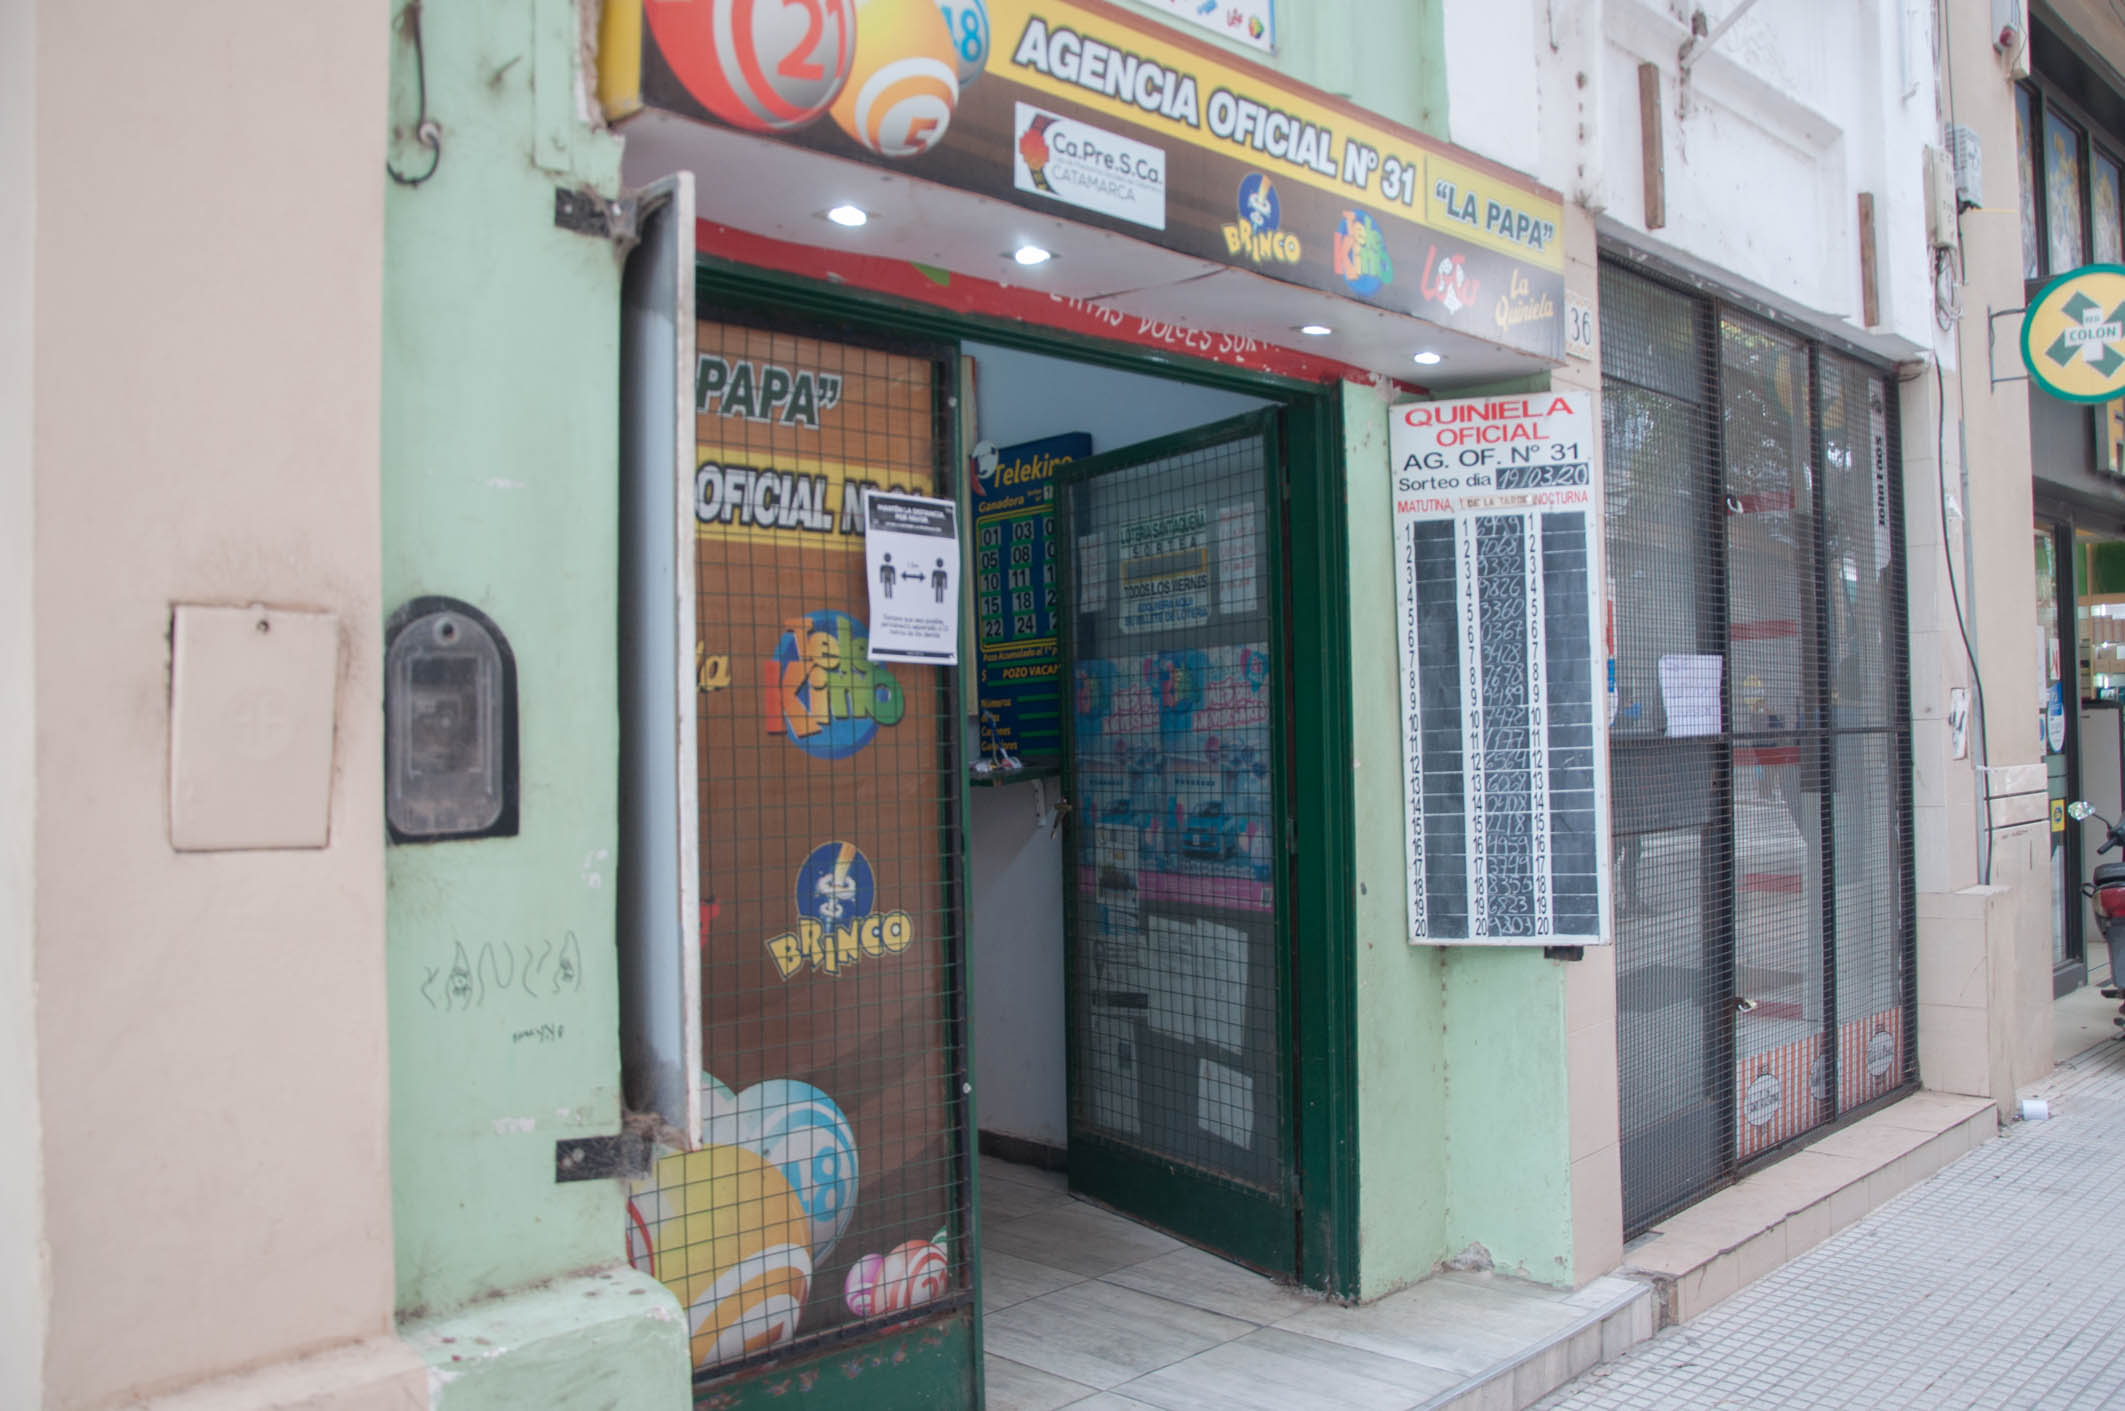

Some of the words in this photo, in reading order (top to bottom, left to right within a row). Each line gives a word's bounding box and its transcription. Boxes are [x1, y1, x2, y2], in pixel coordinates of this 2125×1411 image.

[1011, 13, 1200, 128] AGENCIA
[1207, 86, 1337, 179] OFICIAL
[1381, 154, 1416, 208] 31
[1051, 163, 1136, 201] CATAMARCA
[1220, 216, 1301, 264] BRINCO
[1510, 268, 1529, 299] La
[1495, 293, 1554, 332] Quiniela
[1570, 306, 1592, 346] 36
[2069, 325, 2117, 341] COLON
[1404, 396, 1574, 427] QUINIELA
[1436, 421, 1550, 447] OFICIAL
[1403, 452, 1449, 472] AG.
[1458, 447, 1502, 467] OF.
[1550, 443, 1579, 462] 31
[1399, 477, 1459, 492] Sorteo
[1466, 472, 1491, 487] dia
[694, 462, 834, 533] OFICIAL
[1397, 497, 1452, 513] MATUTINA
[1463, 518, 1468, 536] 1
[1528, 513, 1533, 530] 1
[983, 529, 999, 546] 01
[1015, 522, 1033, 539] 03
[1405, 524, 1410, 541] 1
[1464, 541, 1470, 558] 2
[1530, 535, 1536, 552] 2
[982, 551, 999, 569] 05
[1013, 546, 1030, 563] 08
[1406, 547, 1412, 563] 2
[1465, 562, 1471, 579] 3
[1530, 557, 1536, 573] 3
[984, 574, 999, 590] 10
[1012, 570, 1026, 586] 11
[1407, 567, 1413, 584] 3
[1465, 582, 1472, 599] 4
[1530, 577, 1536, 594] 4
[984, 598, 999, 615] 15
[1016, 592, 1032, 609] 18
[1407, 588, 1413, 605] 4
[1467, 604, 1473, 621] 5
[1531, 599, 1537, 617] 5
[1408, 609, 1414, 626] 5
[985, 620, 1001, 637] 22
[1017, 616, 1034, 633] 24
[1468, 625, 1473, 643] 6
[1531, 621, 1537, 638] 6
[1408, 630, 1414, 647] 6
[1469, 646, 1474, 663] 7
[1532, 642, 1538, 659] 7
[1409, 651, 1415, 668] 7
[1410, 672, 1415, 689] 8
[1470, 667, 1476, 684] 8
[1533, 663, 1539, 681] 8
[1410, 693, 1416, 710] 9
[1470, 689, 1477, 706] 9
[1533, 684, 1539, 702] 9
[1409, 714, 1418, 732] 10
[1470, 710, 1479, 728] 10
[1531, 707, 1541, 725] 10
[1409, 732, 1417, 750] 11
[1471, 731, 1478, 748] 11
[1532, 728, 1540, 745] 11
[1410, 756, 1419, 773] 12
[1471, 753, 1480, 770] 12
[1533, 751, 1542, 768] 12
[1411, 777, 1420, 794] 13
[1472, 774, 1481, 791] 13
[1533, 772, 1543, 789] 13
[1411, 797, 1420, 815] 14
[1472, 795, 1482, 812] 14
[1533, 792, 1543, 809] 14
[1412, 818, 1422, 835] 15
[1473, 816, 1482, 833] 15
[1534, 814, 1544, 831] 15
[1413, 838, 1422, 855] 16
[1473, 836, 1483, 854] 16
[1535, 835, 1545, 852] 16
[1413, 859, 1422, 875] 17
[1474, 857, 1482, 874] 17
[1536, 856, 1544, 873] 17
[1414, 878, 1423, 895] 18
[1474, 877, 1484, 894] 18
[1536, 876, 1546, 893] 18
[1415, 899, 1424, 916] 19
[1475, 898, 1484, 915] 19
[1537, 897, 1546, 914] 19
[1415, 920, 1426, 937] 20
[1476, 918, 1487, 936] 20
[1538, 917, 1548, 935] 20
[764, 909, 913, 982] BRINCO
